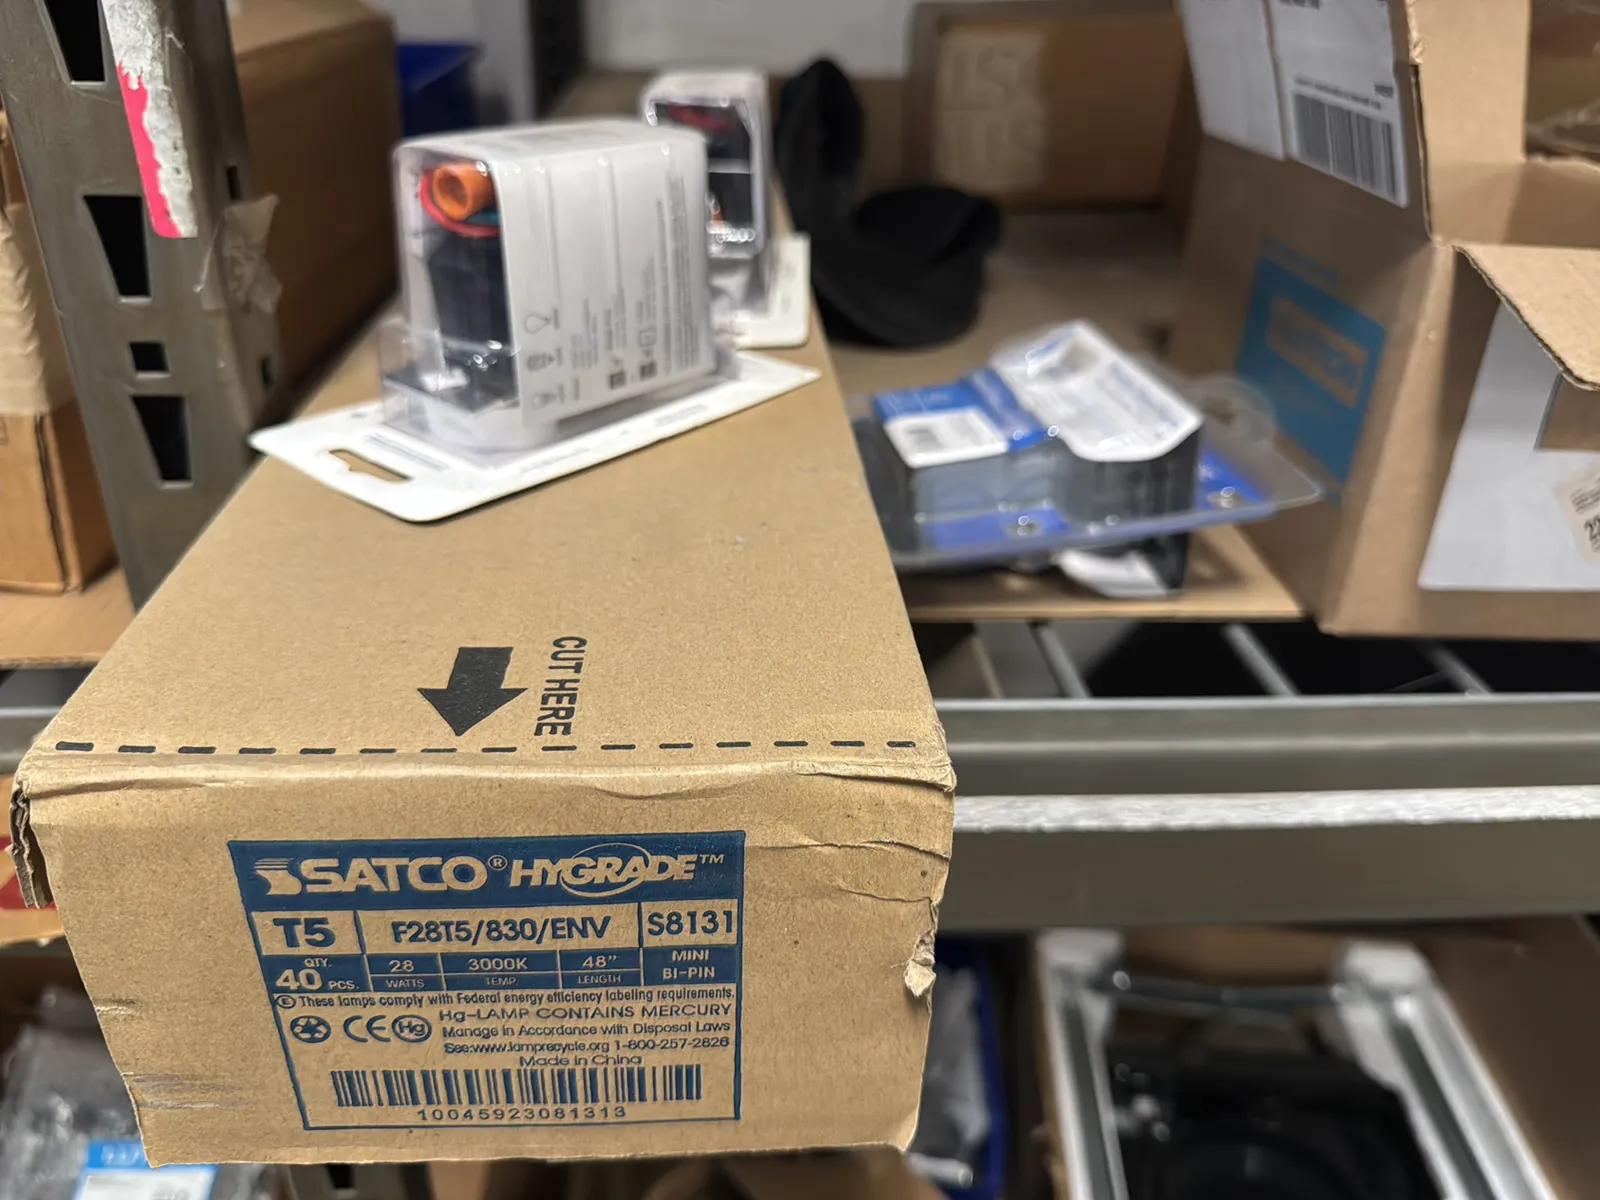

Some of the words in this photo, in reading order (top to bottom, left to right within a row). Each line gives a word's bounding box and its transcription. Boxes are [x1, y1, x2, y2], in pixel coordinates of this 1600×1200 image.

[548, 636, 588, 674] CUT
[534, 679, 580, 736] HERE
[648, 910, 733, 936] S8131
[273, 917, 336, 948] T5
[391, 916, 611, 946] F28T5/830/ENV
[671, 949, 709, 961] MINI
[304, 958, 332, 968] QTY.
[388, 960, 415, 972] 28
[468, 957, 529, 971] 3000K
[275, 969, 323, 990] 40
[328, 980, 359, 990] PCS.
[577, 974, 621, 985] LENGTH
[662, 966, 715, 981] BI-PIN
[386, 979, 425, 989] WATTS
[299, 996, 335, 1007] These
[338, 995, 375, 1009] lamps
[379, 994, 424, 1008] comply
[428, 994, 453, 1005] with
[457, 992, 501, 1004] Federal
[504, 992, 544, 1005] energy
[547, 990, 602, 1004] efficiency
[605, 989, 653, 1002] labeling
[657, 987, 735, 1001] requirements.
[439, 1008, 529, 1022] Hg-LAMP
[536, 1006, 635, 1019] CONTAINS
[641, 1004, 732, 1017] MERCURY
[442, 1025, 498, 1039] Manage
[502, 1024, 516, 1036] in
[518, 1023, 597, 1036] Accordance
[600, 1023, 629, 1035] with
[633, 1022, 691, 1036] Disposal
[696, 1021, 731, 1032] Laws
[615, 1036, 730, 1050] 1-800-257-2826
[519, 1055, 570, 1067] Made
[574, 1055, 588, 1066] in
[592, 1053, 643, 1066] China
[417, 1106, 627, 1121] 10045923081313
